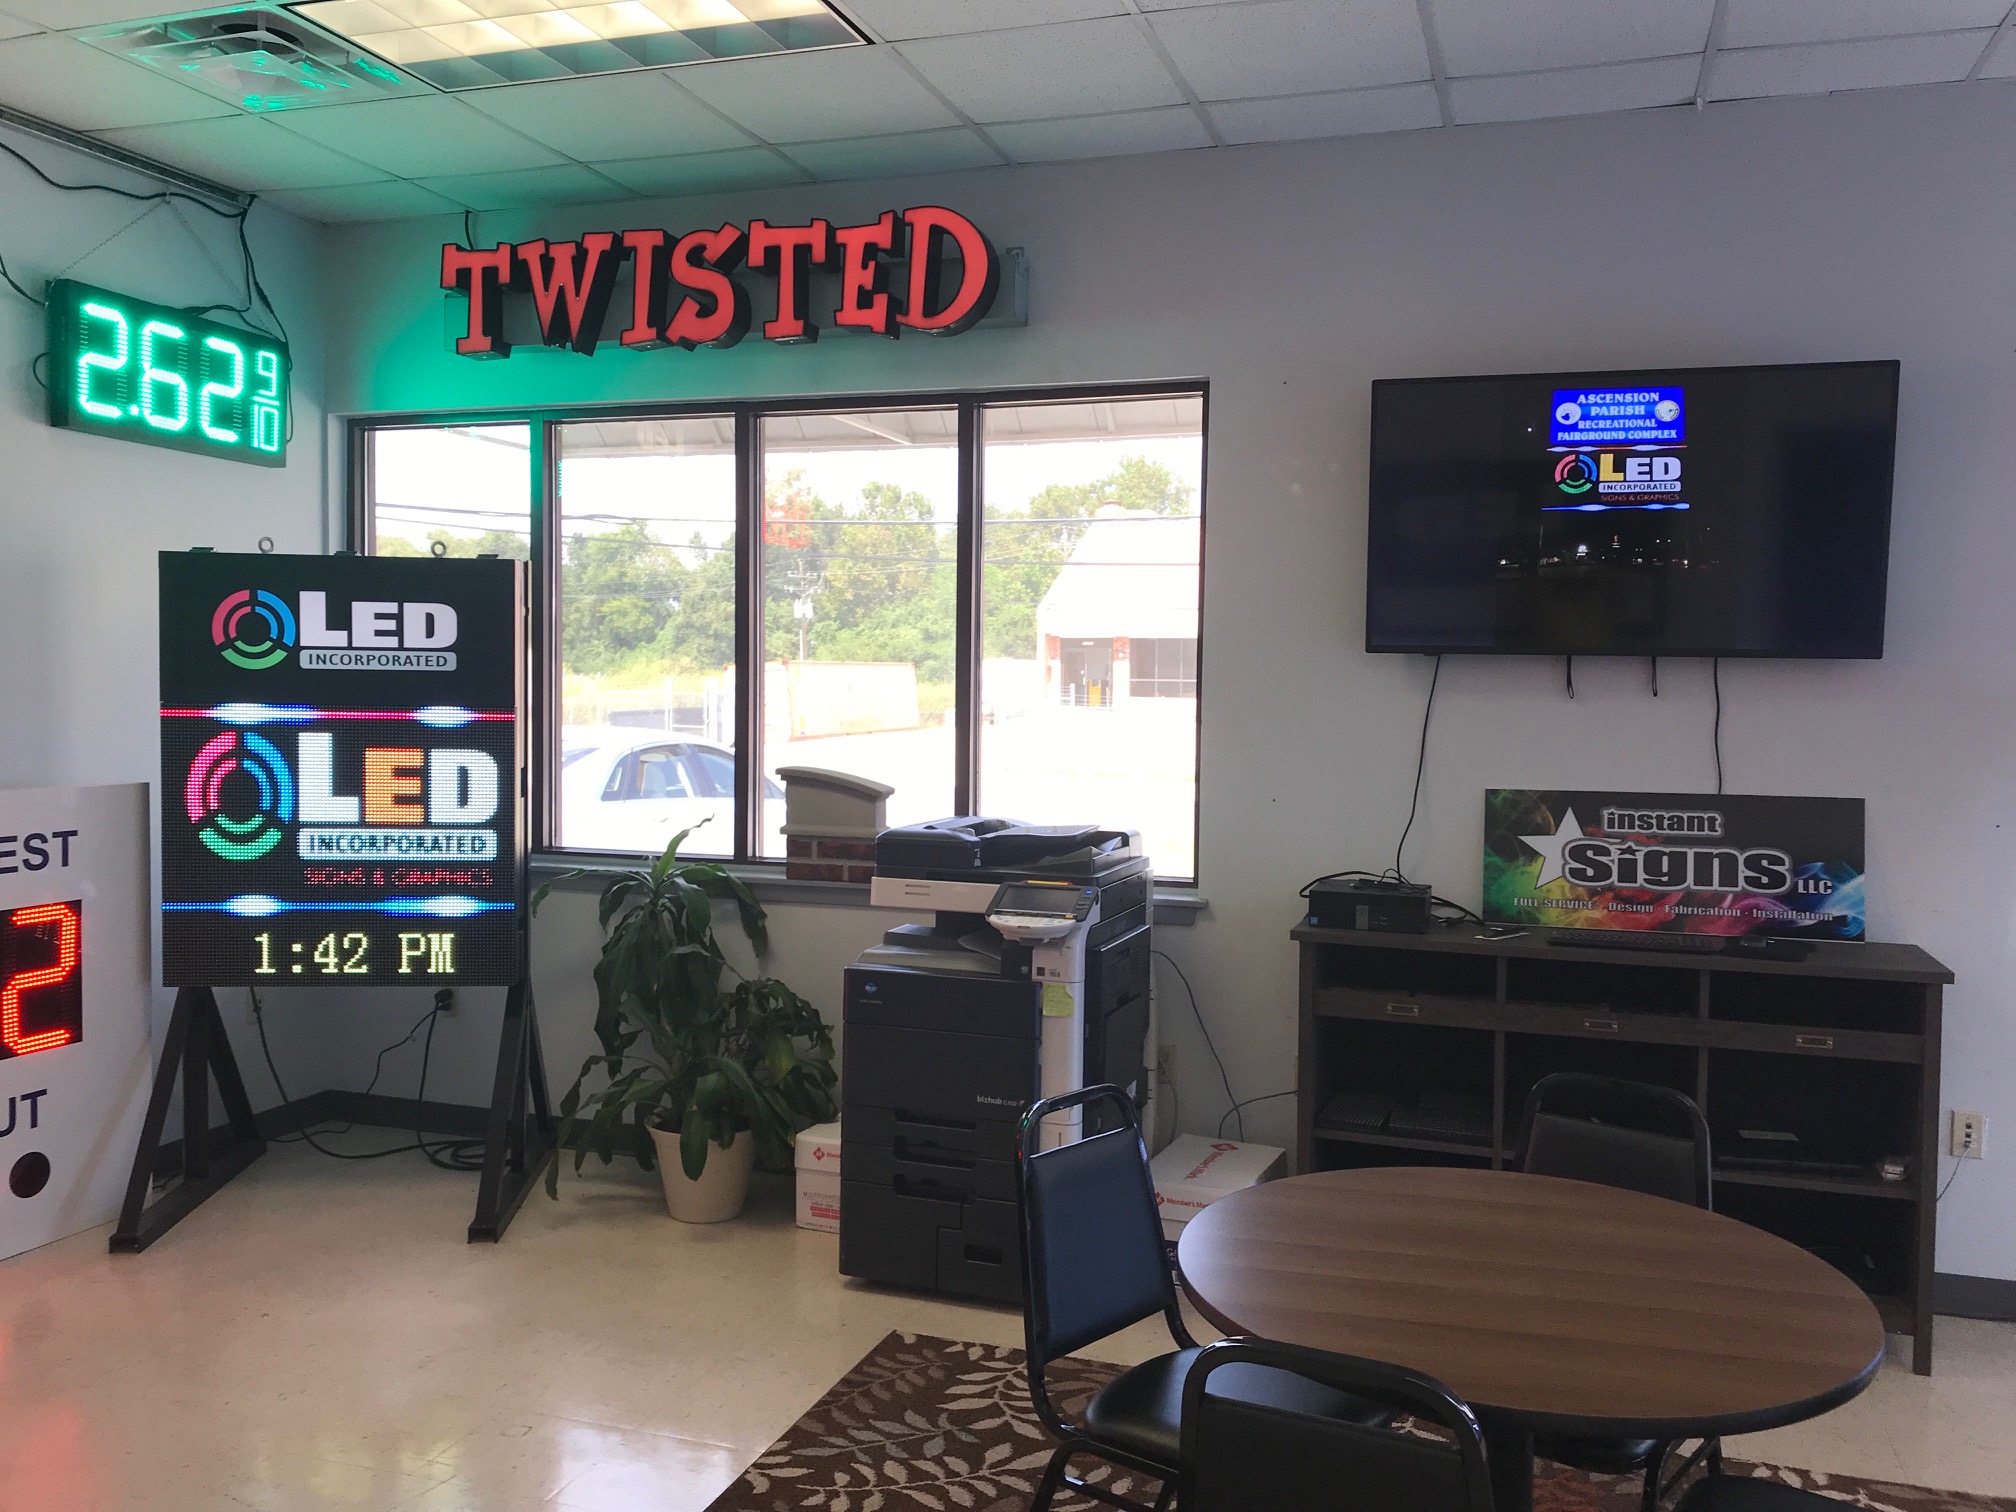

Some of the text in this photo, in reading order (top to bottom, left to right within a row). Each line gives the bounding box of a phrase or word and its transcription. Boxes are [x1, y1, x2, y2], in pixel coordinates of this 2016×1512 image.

[441, 205, 994, 356] TWISTED
[77, 302, 245, 444] 2.62
[1576, 392, 1660, 404] ASCENSION
[1590, 405, 1646, 416] PARISH
[1577, 418, 1658, 430] RECREATIONAL
[1557, 429, 1678, 441] FAIRGROUND COMPLEX
[1602, 482, 1677, 492] INCORPORATED
[1600, 494, 1628, 502] SIGNS
[1637, 493, 1680, 502] GRAPHICS
[308, 653, 449, 668] INCORPORATED
[309, 834, 487, 854] INCORPORATED
[1564, 840, 1794, 893] Signs
[1797, 879, 1834, 896] LLC
[1513, 897, 1539, 908] FULL
[1608, 902, 1654, 914] Design
[1665, 904, 1742, 918] Fabrication
[1752, 907, 1834, 922] Installation
[253, 932, 455, 975] 1:42 PM
[1, 902, 79, 1055] 2
